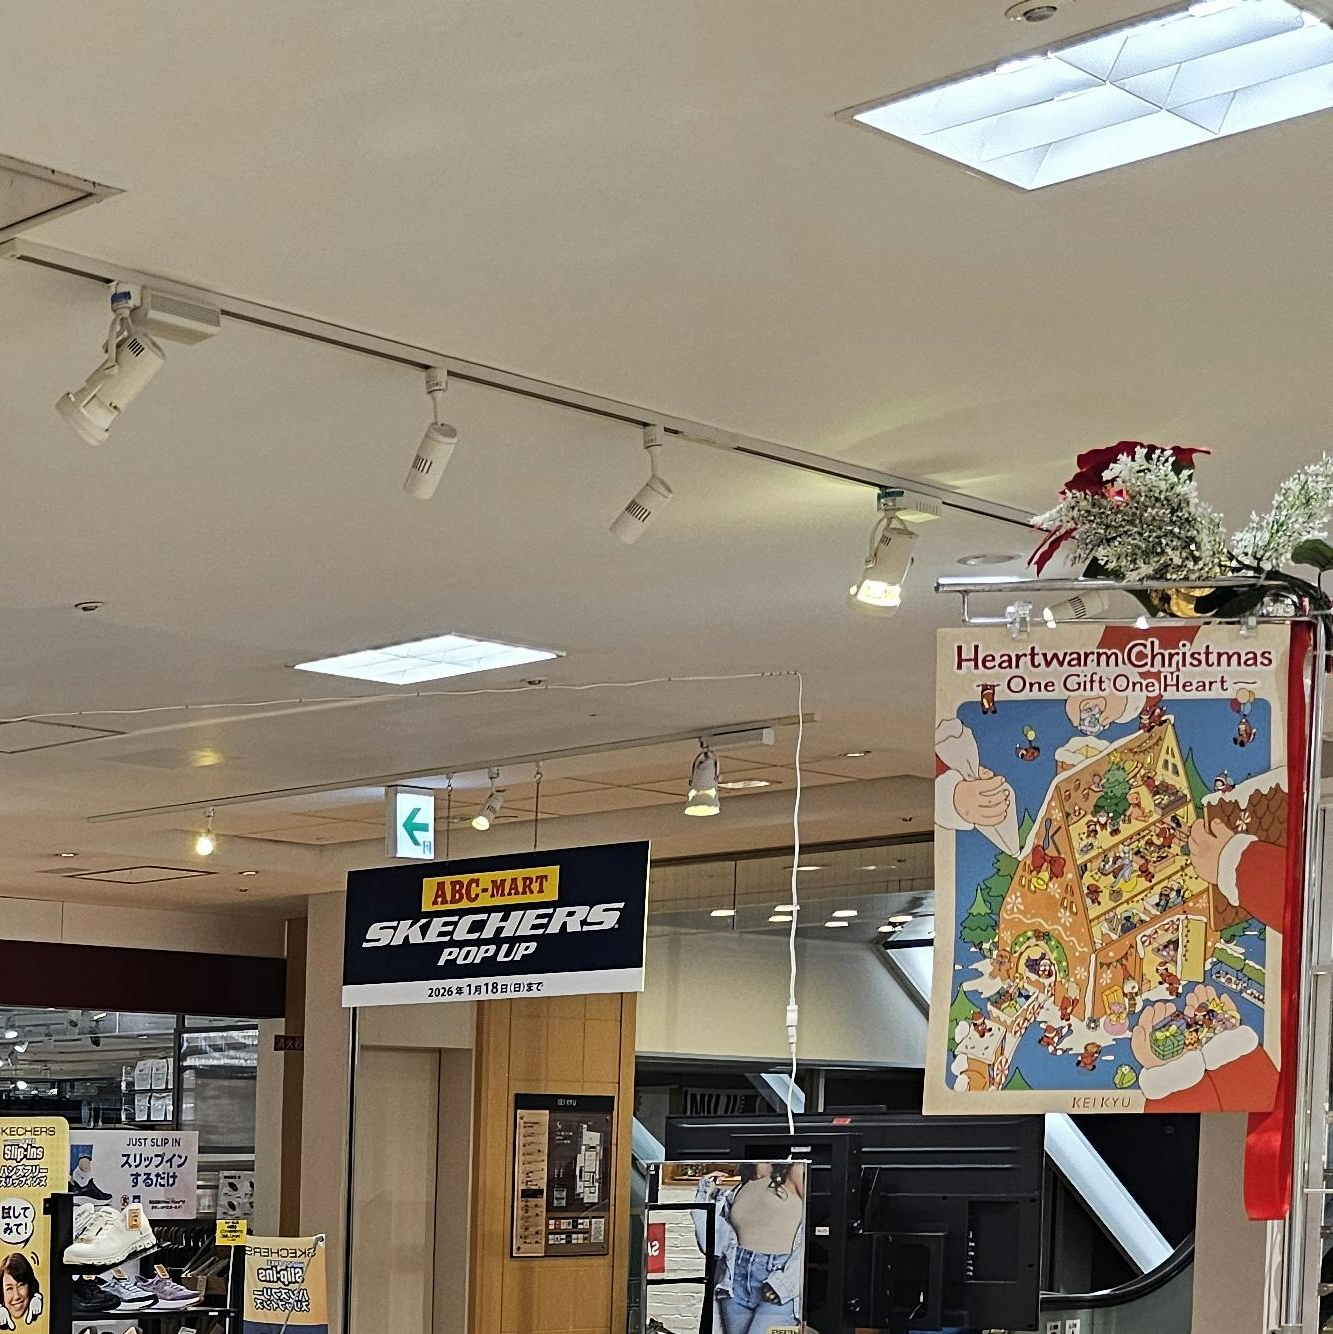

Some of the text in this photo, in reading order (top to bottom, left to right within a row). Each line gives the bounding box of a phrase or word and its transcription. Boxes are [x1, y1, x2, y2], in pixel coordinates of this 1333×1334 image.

[955, 640, 1273, 671] Heartwarm Christmas
[1006, 673, 1229, 694] One Gift One Heart
[432, 874, 548, 906] ABC-MART
[362, 902, 625, 948] SKECHERS
[437, 941, 537, 966] POP UP
[127, 1137, 181, 1147] JUST SLIP IN
[121, 1152, 188, 1168] スリップイン
[130, 1172, 178, 1188] するだけ
